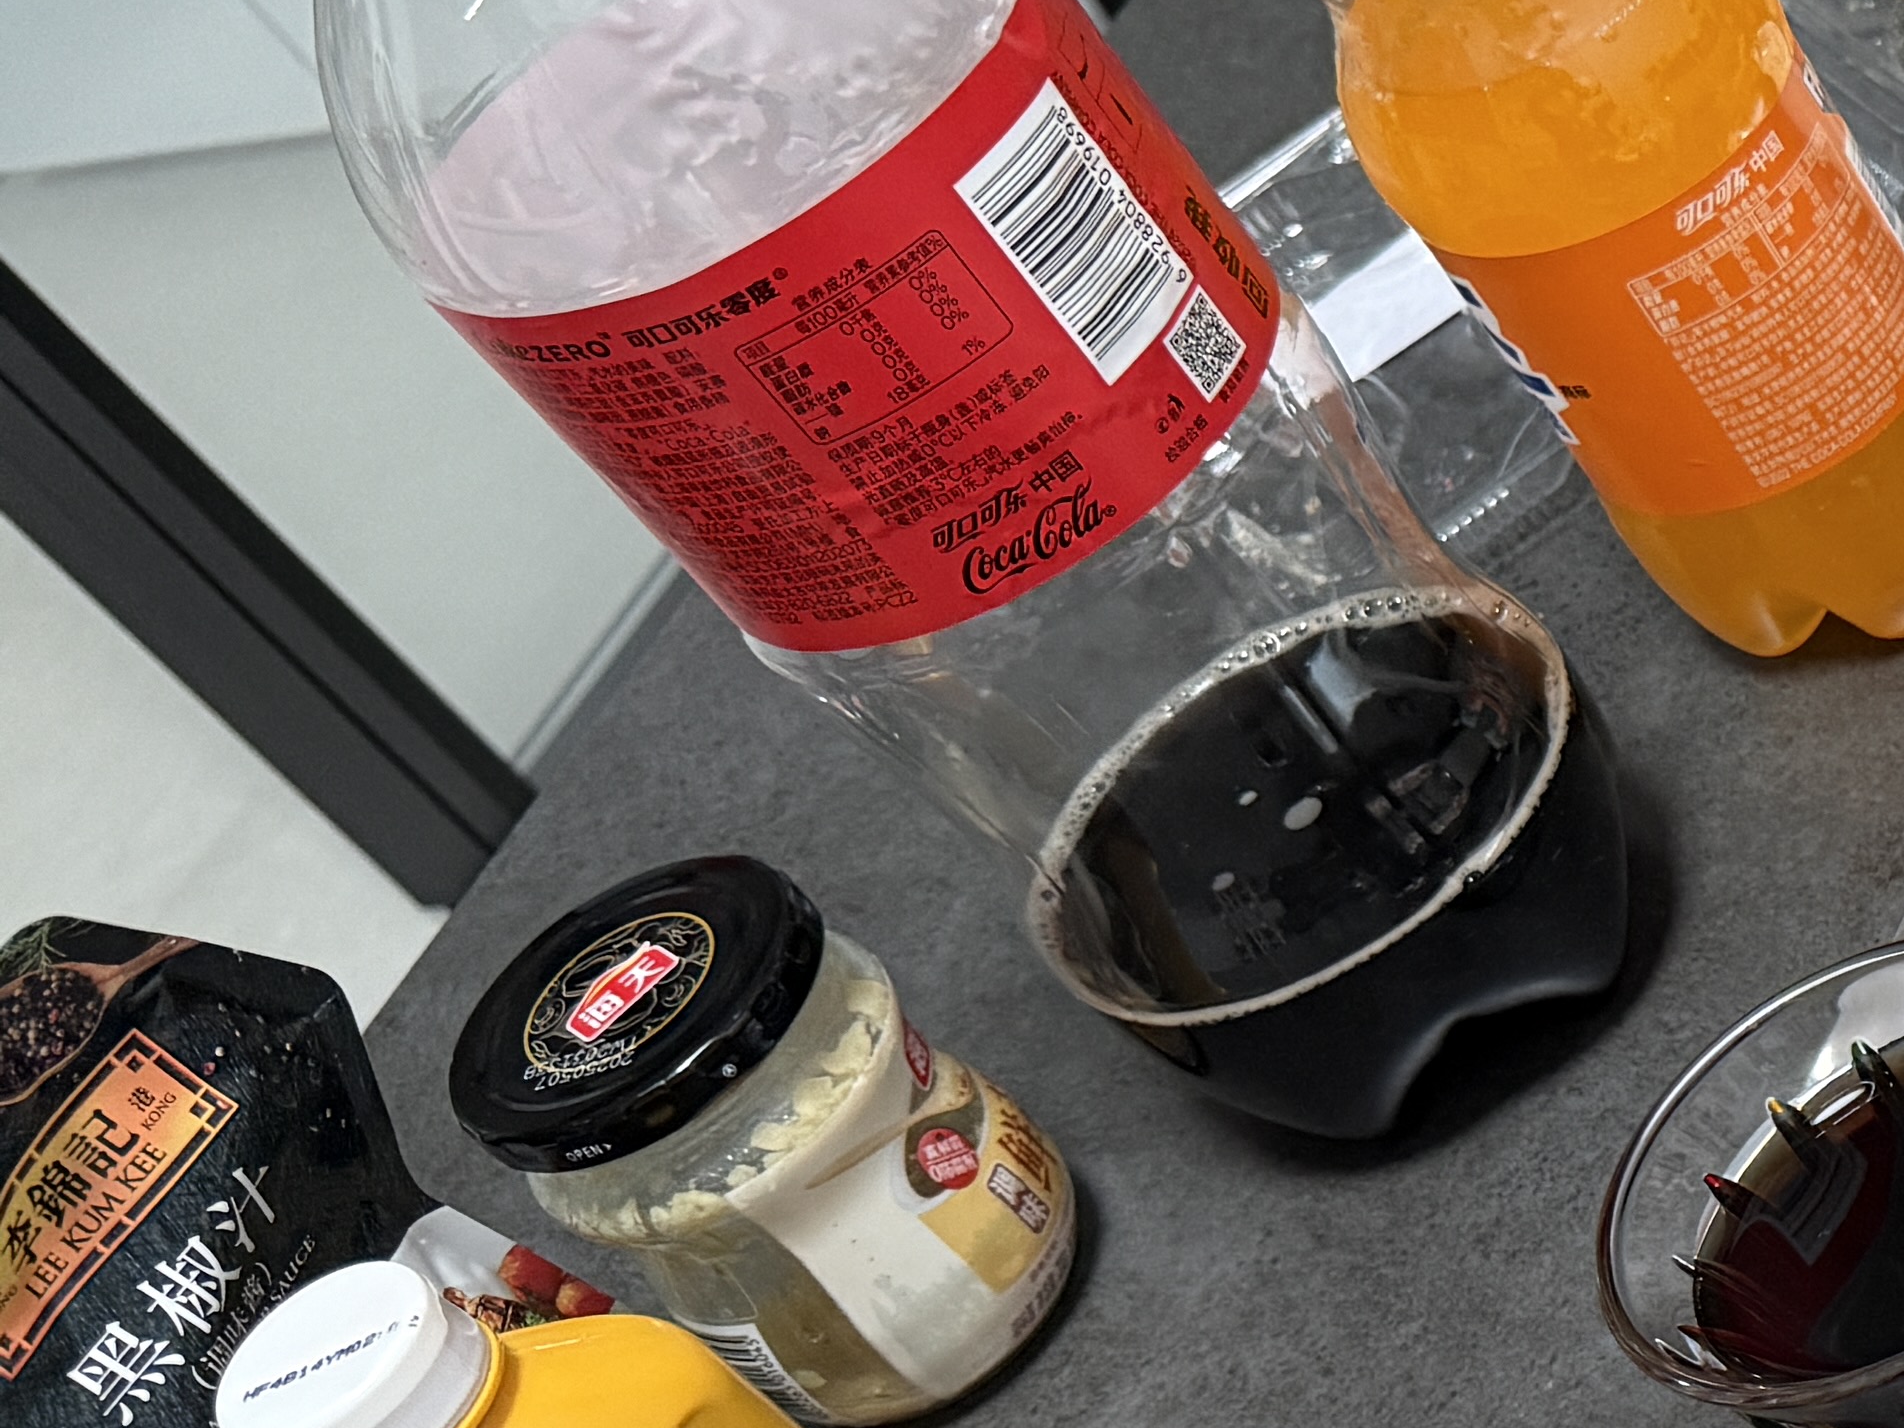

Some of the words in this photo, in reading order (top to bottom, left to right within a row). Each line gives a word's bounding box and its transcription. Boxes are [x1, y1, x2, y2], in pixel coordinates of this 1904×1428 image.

[1055, 104, 1112, 187] 019698
[1675, 158, 1752, 236] 可口可乐
[1746, 129, 1785, 170] 中国
[1116, 186, 1172, 266] 928804
[621, 274, 780, 353] 可口可乐零度
[1174, 267, 1188, 285] 6
[529, 336, 612, 367] ZERO
[928, 478, 1031, 556] 可口可乐
[1026, 448, 1084, 494] 中国
[140, 1090, 178, 1133] KONG
[2, 1108, 139, 1266] 李錦記
[565, 1143, 604, 1163] OPEN
[24, 1252, 70, 1301] LEE
[60, 1196, 128, 1256] KUM
[126, 1141, 168, 1195] KEE
[66, 1165, 276, 1427] 黑椒汁
